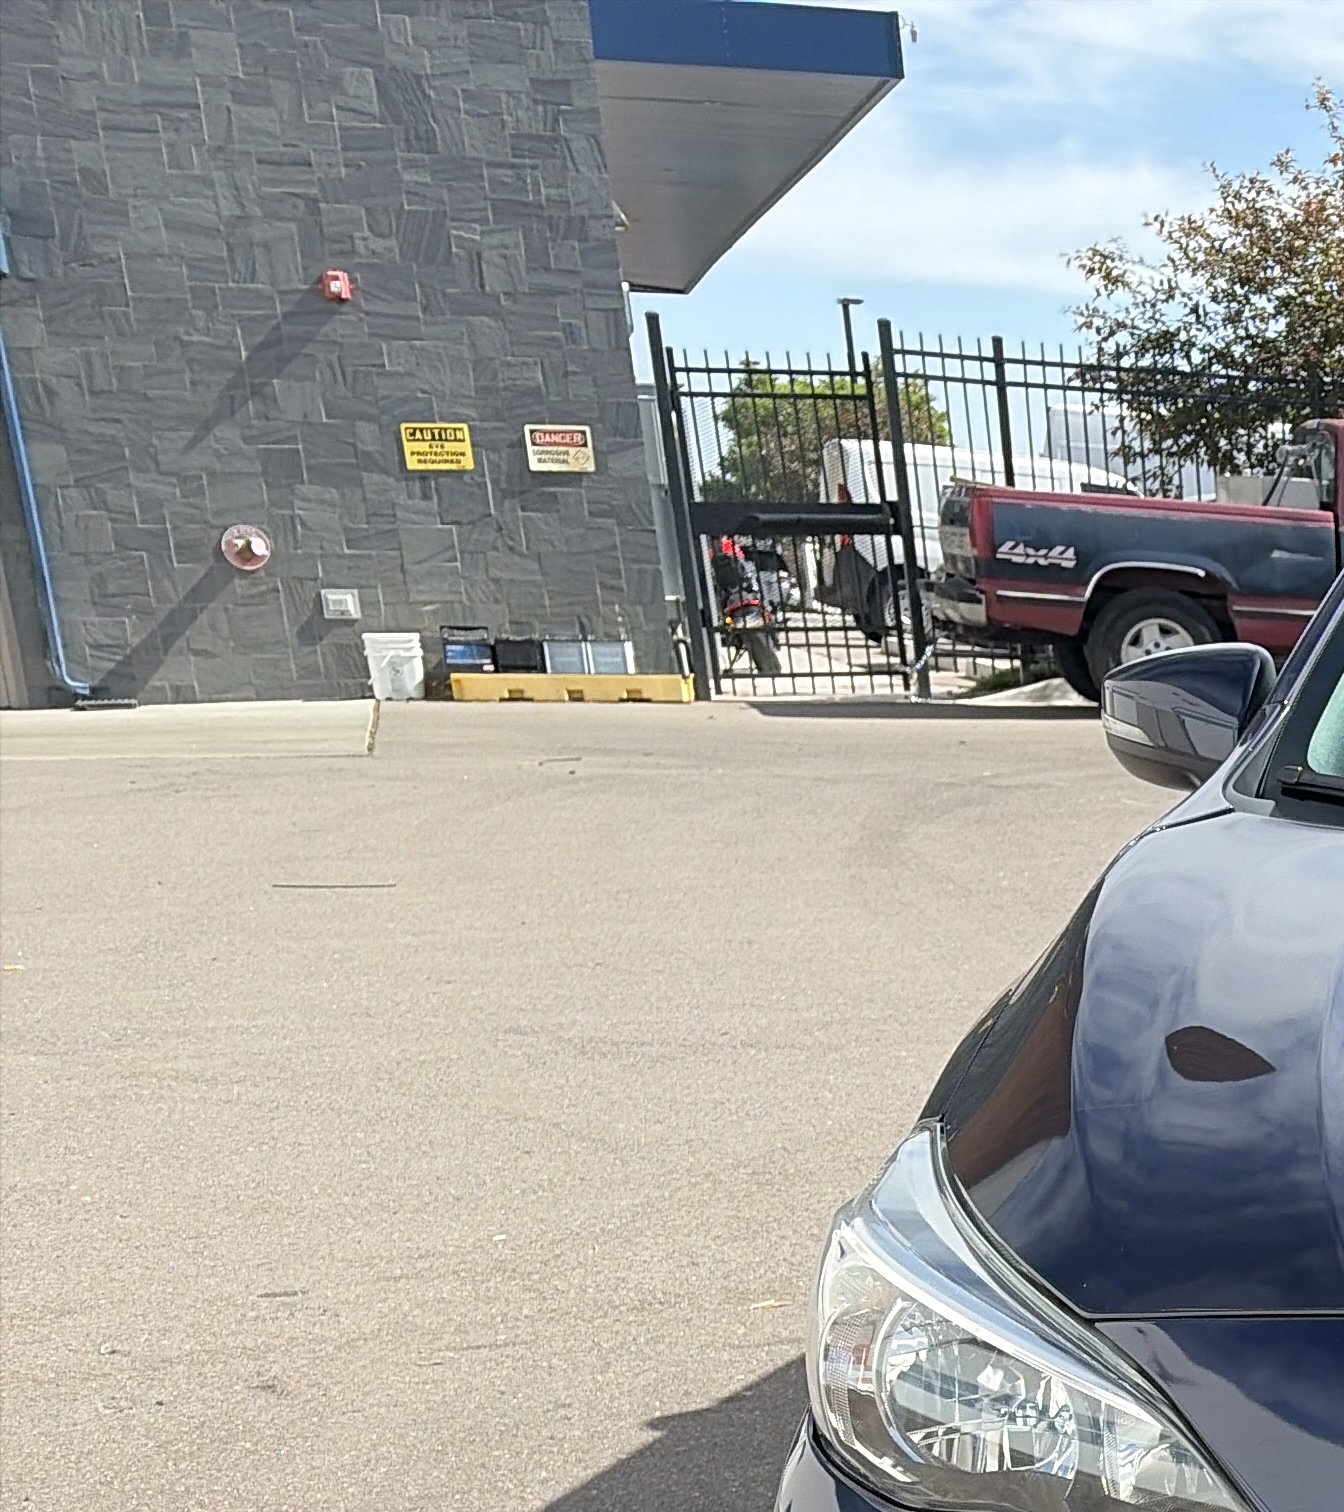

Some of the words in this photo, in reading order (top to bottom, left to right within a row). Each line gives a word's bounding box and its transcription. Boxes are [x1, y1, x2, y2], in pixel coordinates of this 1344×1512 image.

[405, 428, 465, 441] CAUTION
[535, 431, 582, 444] DANGER
[995, 540, 1077, 569] 4x4
